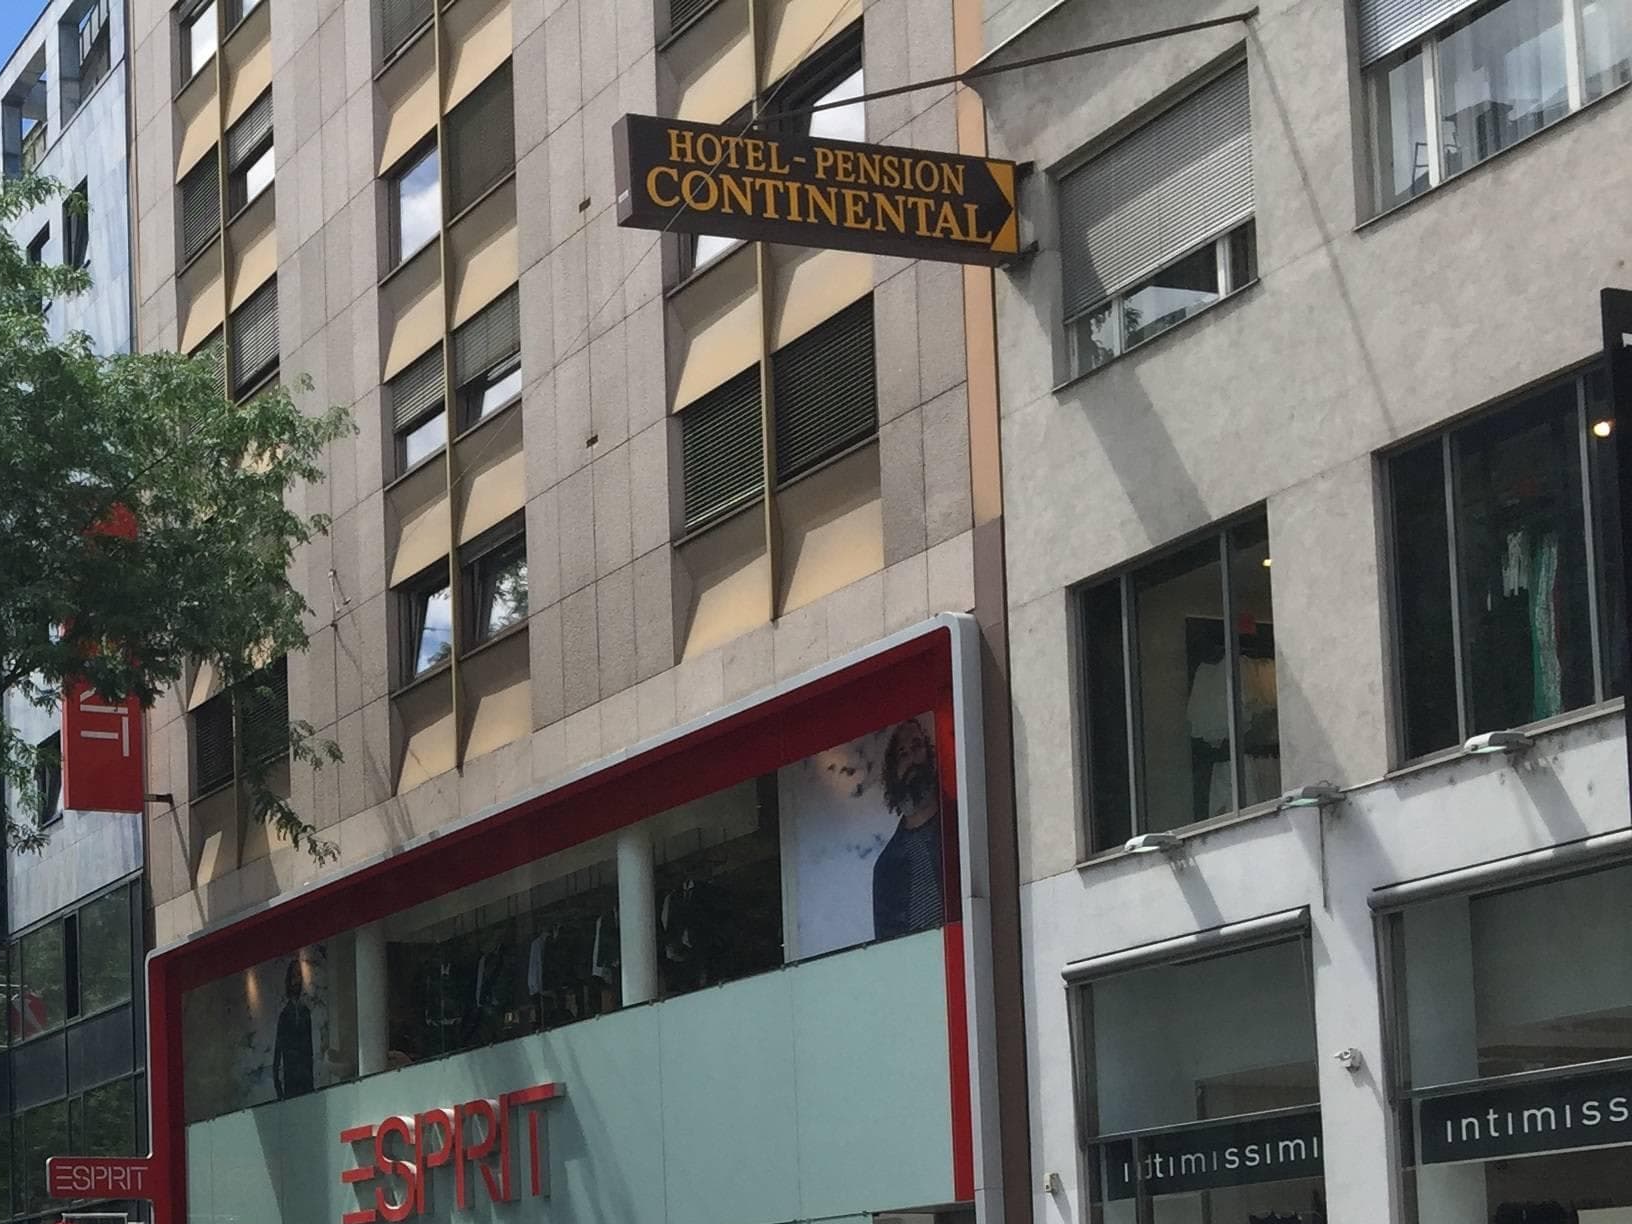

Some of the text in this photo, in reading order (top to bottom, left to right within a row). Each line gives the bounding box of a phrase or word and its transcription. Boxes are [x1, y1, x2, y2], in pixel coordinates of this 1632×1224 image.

[667, 128, 790, 175] HOTEL
[813, 147, 966, 196] PENSION
[645, 165, 993, 244] CONTINENTAL
[55, 1165, 149, 1191] ESPRIT
[1123, 1135, 1319, 1183] itimissimi
